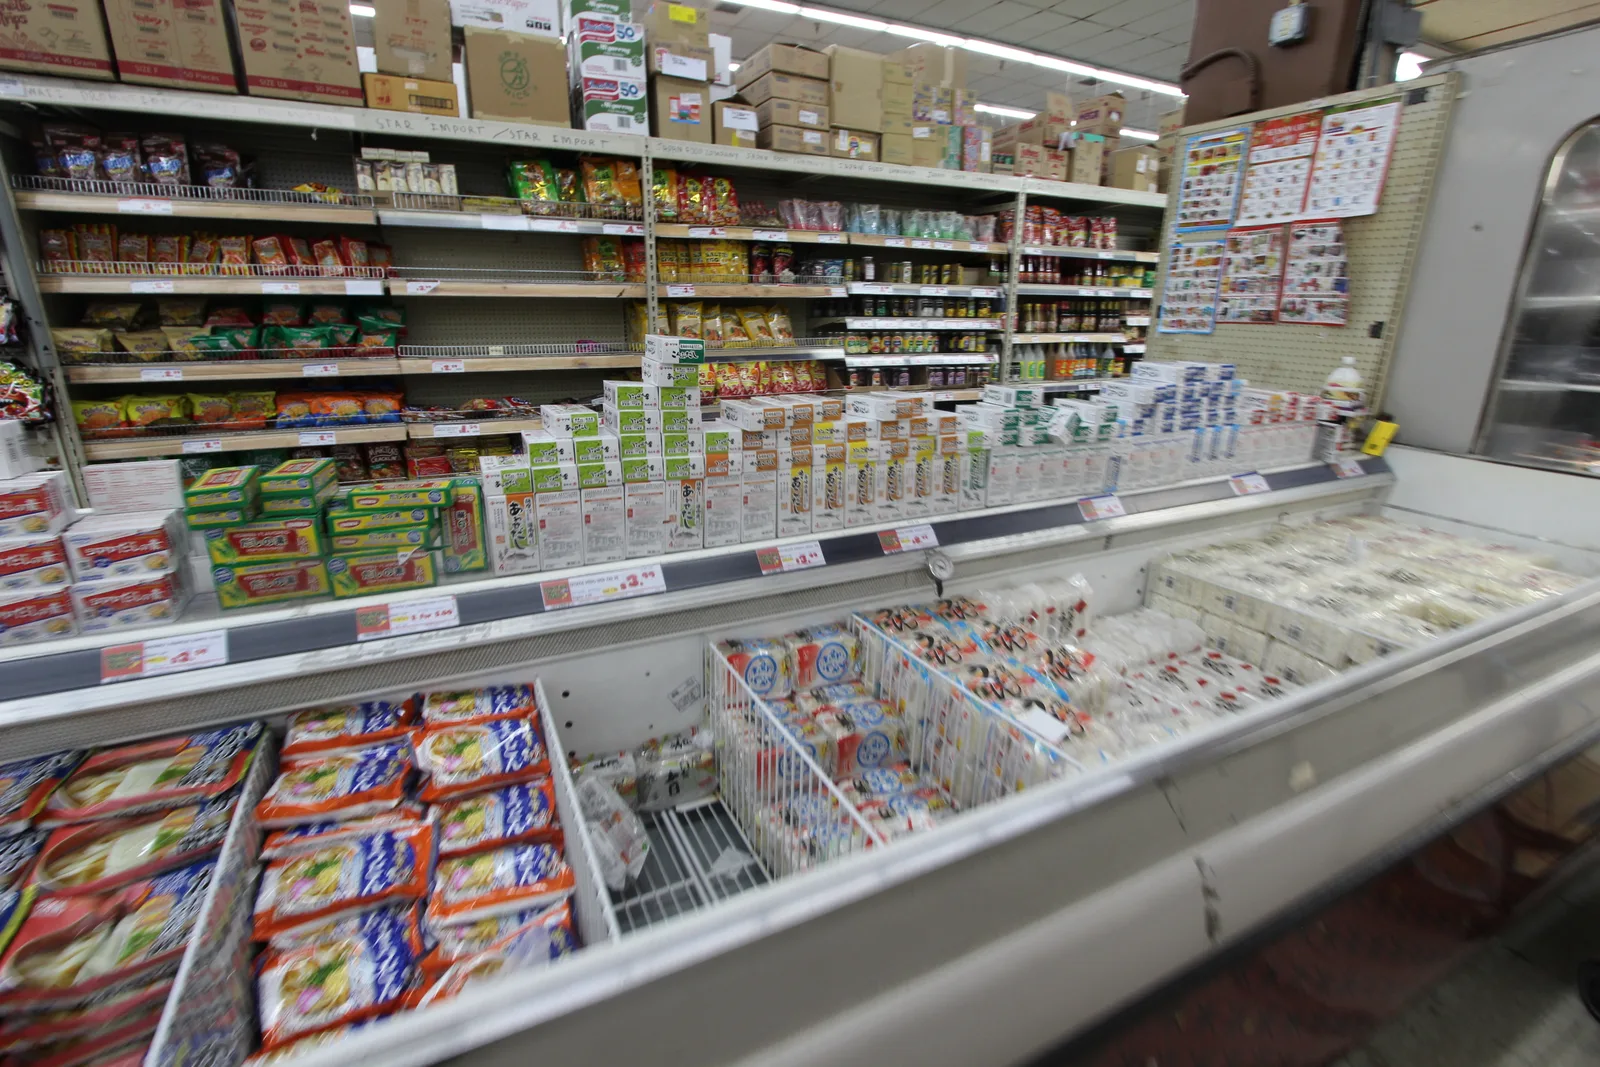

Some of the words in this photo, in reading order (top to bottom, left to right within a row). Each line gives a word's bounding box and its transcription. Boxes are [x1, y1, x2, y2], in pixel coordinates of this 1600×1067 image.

[376, 118, 414, 131] STAR
[430, 122, 485, 135] IMPORT
[552, 134, 610, 149] IMPORT
